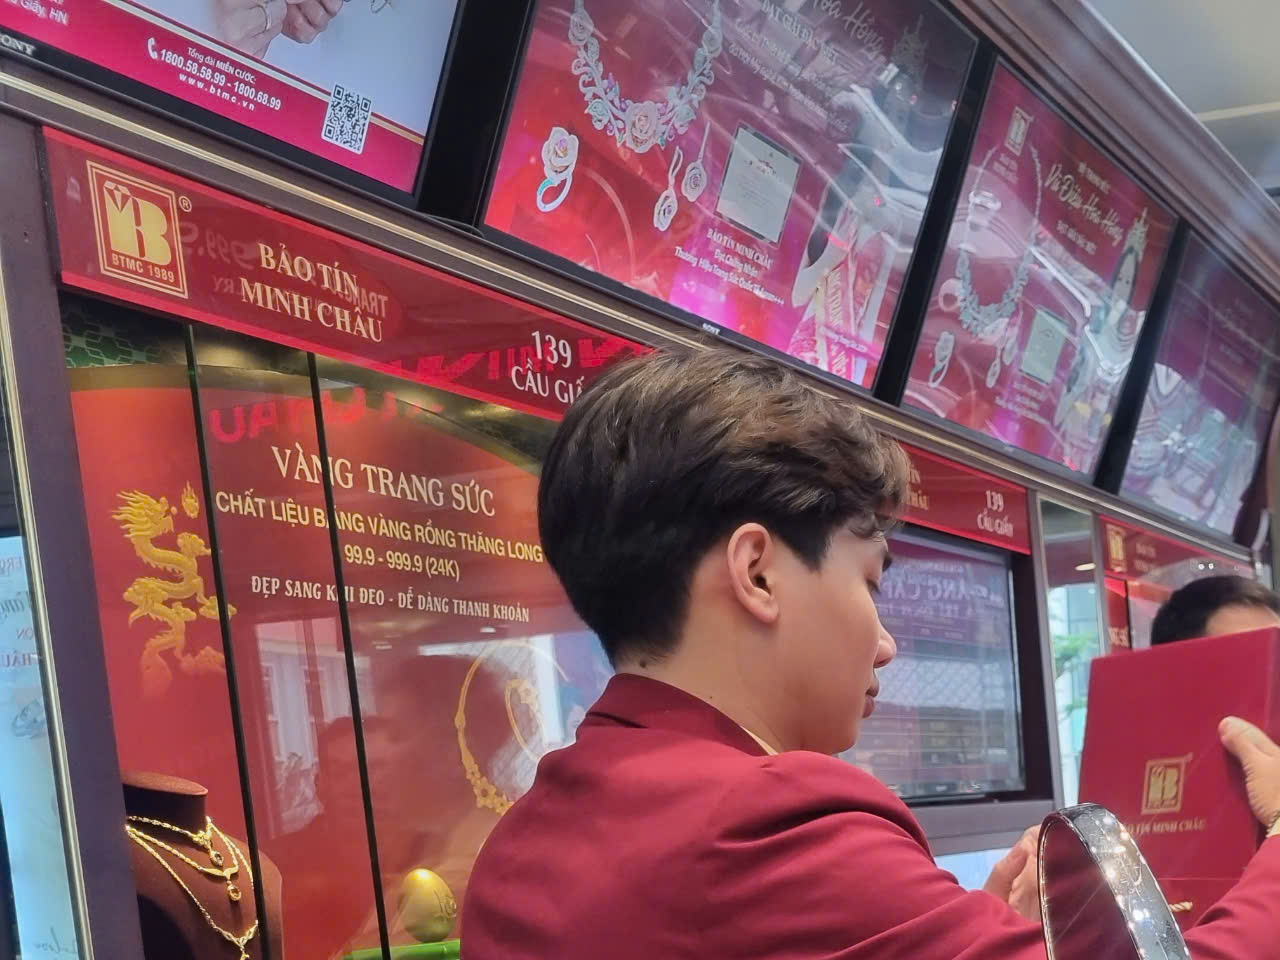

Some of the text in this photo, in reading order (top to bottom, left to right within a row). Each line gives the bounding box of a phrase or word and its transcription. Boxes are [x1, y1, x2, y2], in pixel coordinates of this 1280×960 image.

[0, 33, 37, 56] ONY
[160, 49, 226, 86] 1800.58.58.99
[233, 81, 282, 111] 1800.68.99
[112, 253, 175, 283] BTMC 1989
[257, 242, 359, 297] BẢO TÍN
[239, 277, 312, 322] MINH
[316, 302, 384, 343] CHÂU
[531, 330, 572, 368] 139
[511, 359, 550, 397] CẦU
[271, 442, 497, 518] VÀNG TRANG SỨC
[985, 490, 1004, 511] 139
[215, 488, 267, 518] CHẤT
[270, 498, 310, 528] LIỆU
[367, 512, 411, 542] VÀNG
[414, 518, 457, 549] RỒNG
[457, 530, 506, 557] THĂNG
[507, 539, 544, 563] LONG
[344, 544, 375, 567] 99.9
[386, 551, 423, 574] 999.9
[425, 557, 460, 582] (24K)
[251, 575, 281, 598] ĐẸP
[284, 580, 322, 600] SANG
[359, 587, 385, 606] ĐEO
[397, 585, 415, 610] DỄ
[417, 589, 449, 614] DÀNG
[452, 598, 490, 619] THANH
[493, 600, 530, 623] KHOẢN
